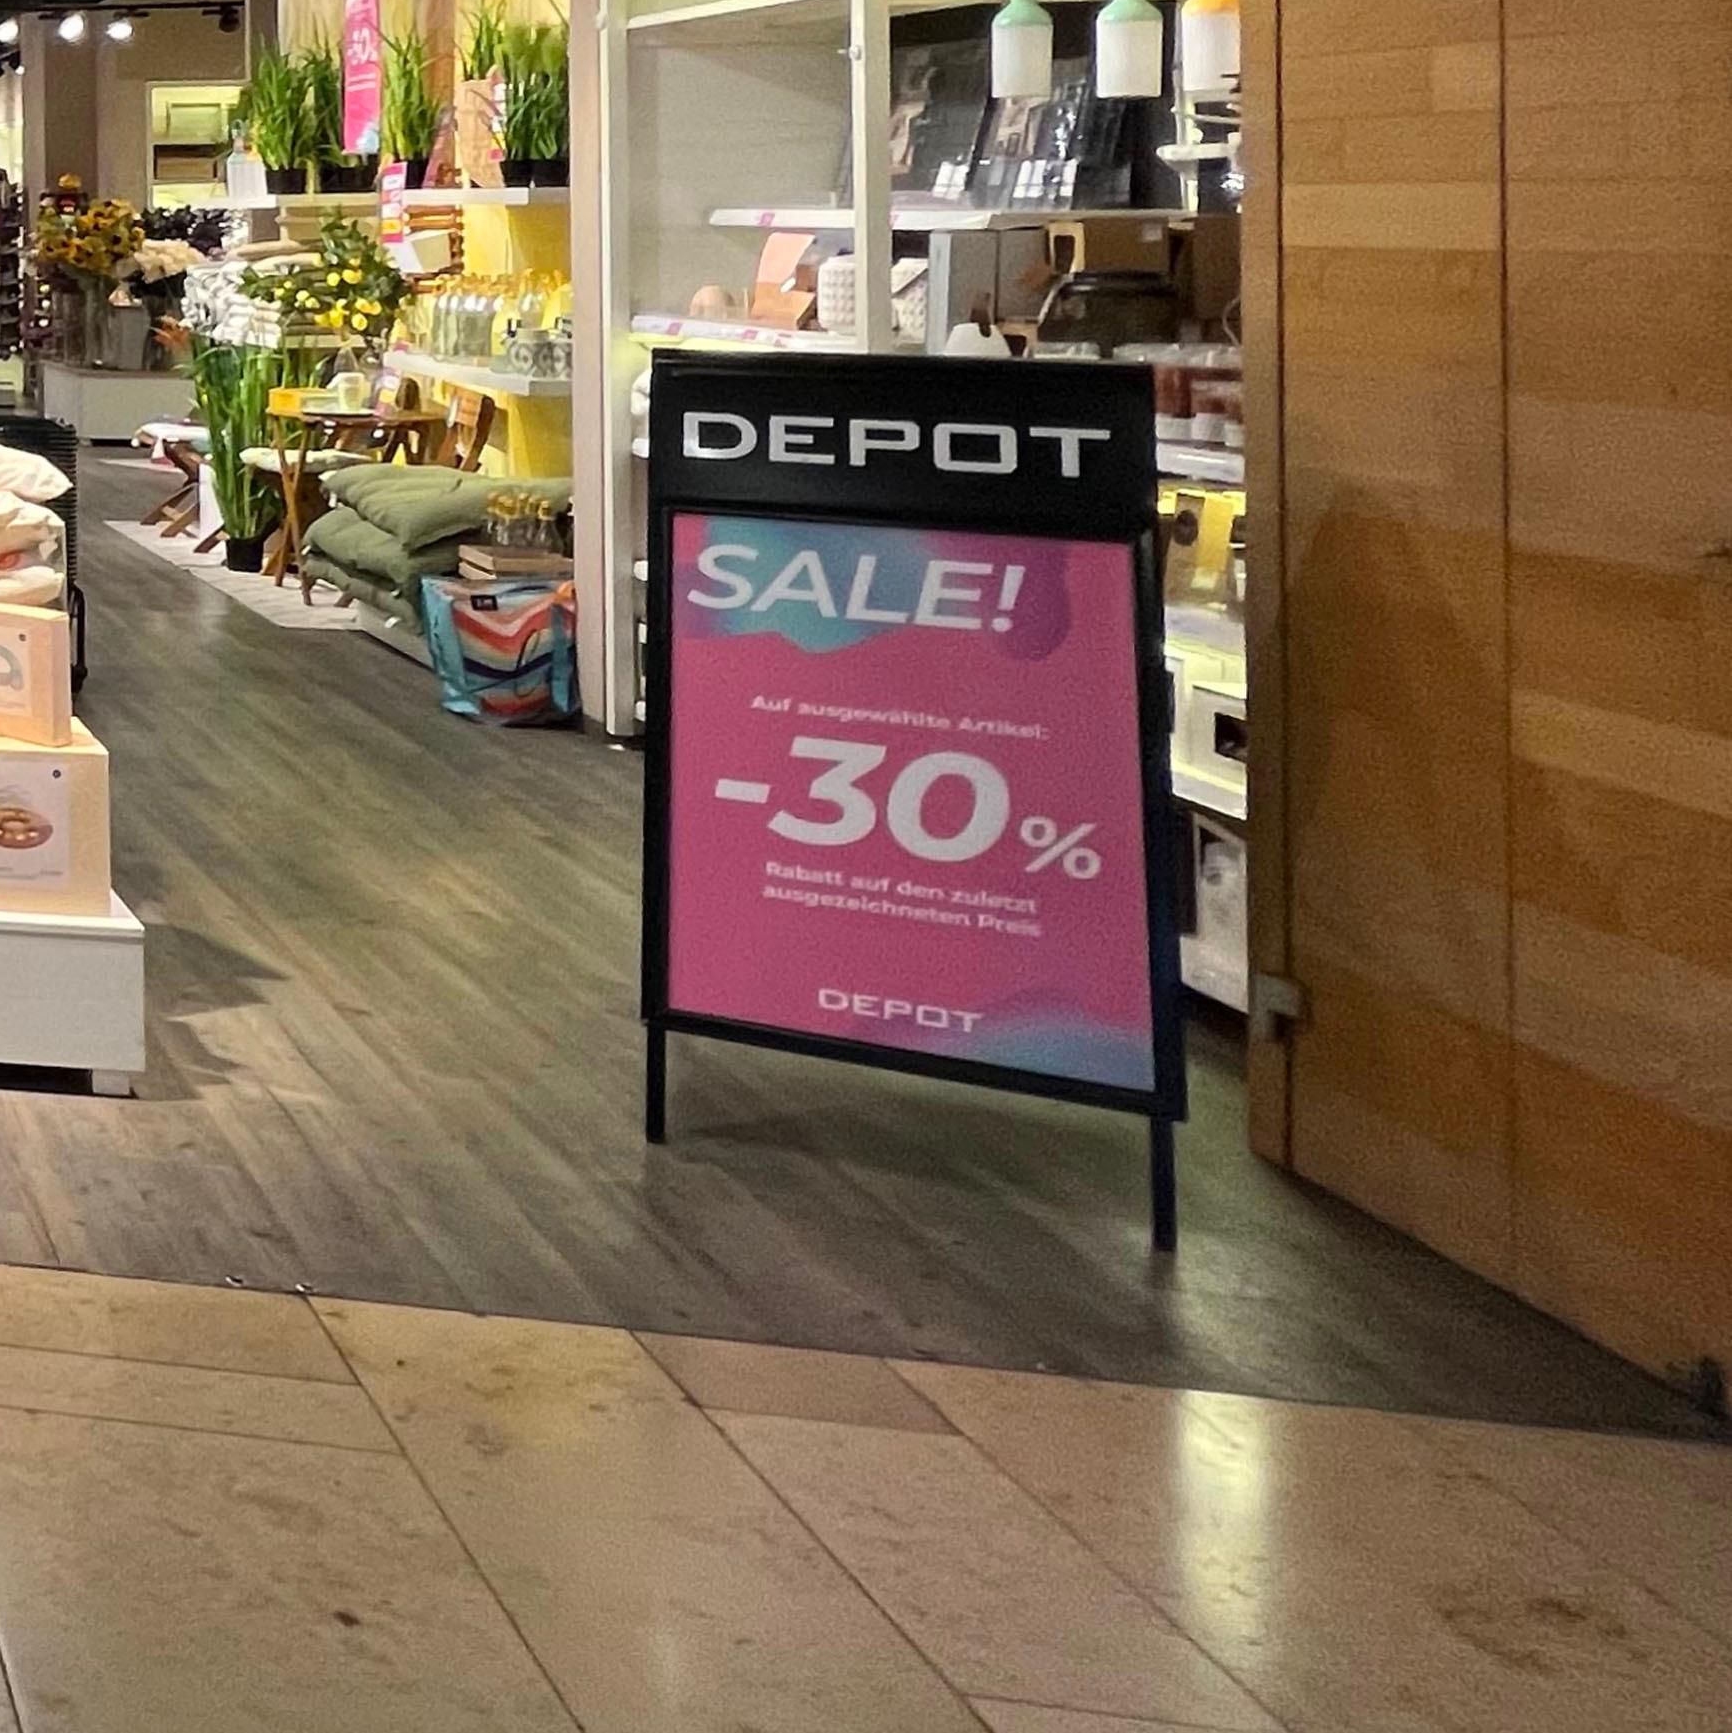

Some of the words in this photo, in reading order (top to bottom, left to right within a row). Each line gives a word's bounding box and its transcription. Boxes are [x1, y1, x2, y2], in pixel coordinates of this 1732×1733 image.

[682, 412, 1111, 478] DEPOT
[687, 543, 1026, 634] SALE!
[751, 695, 791, 712] Auf
[797, 702, 951, 730] ausgewählte
[714, 735, 1102, 880] -30%
[762, 883, 972, 927] ausgezeichneten
[978, 913, 1042, 937] Preis
[765, 861, 843, 887] Rabatt
[850, 876, 892, 894] auf
[896, 879, 947, 902] den
[950, 889, 1038, 915] zuletzt
[817, 987, 983, 1035] DEPOT
